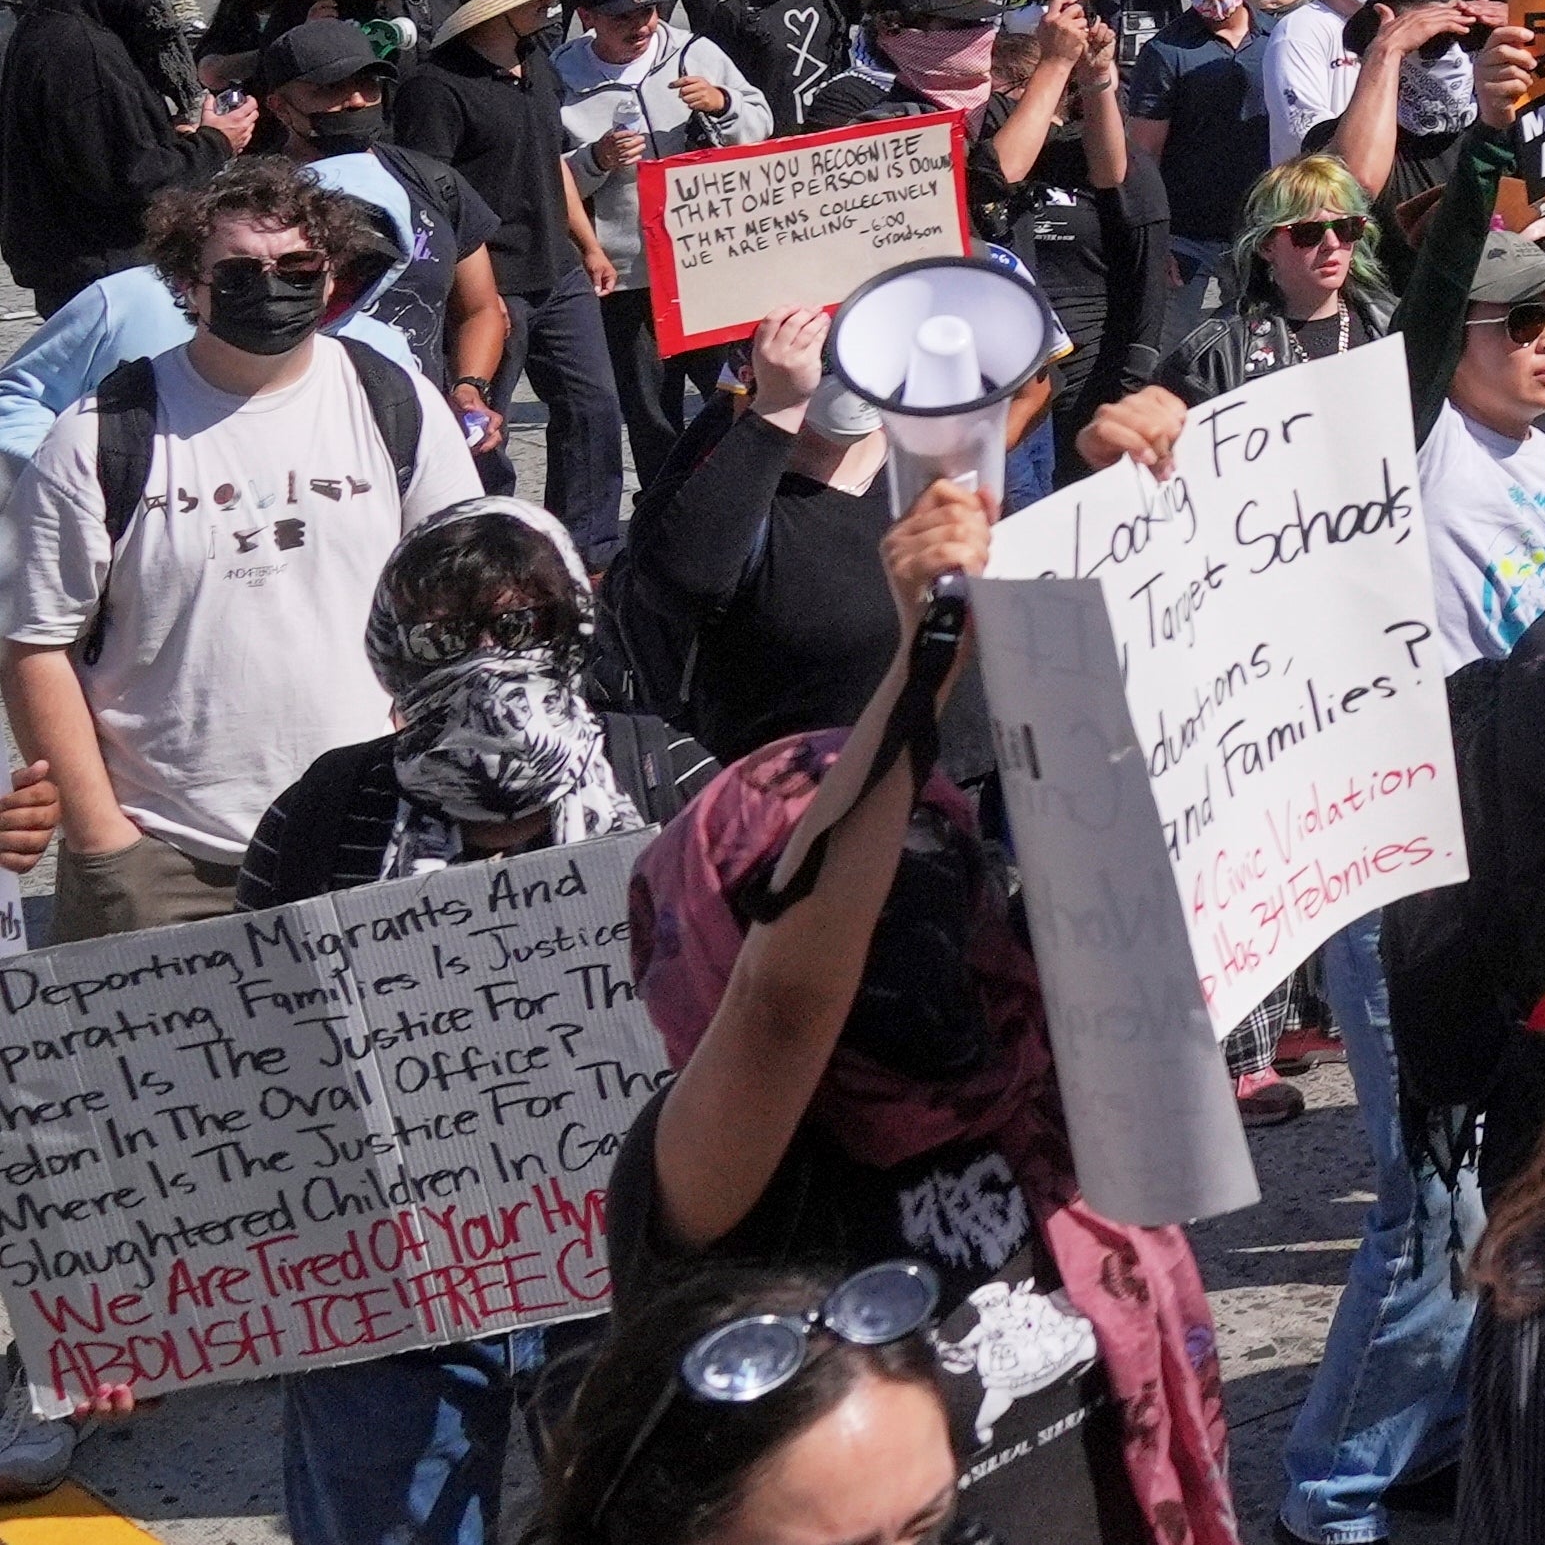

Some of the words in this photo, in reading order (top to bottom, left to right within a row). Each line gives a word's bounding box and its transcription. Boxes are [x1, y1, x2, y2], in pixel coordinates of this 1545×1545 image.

[671, 197, 733, 229] THAT
[741, 186, 786, 214] ONE
[792, 168, 879, 201] PERSON
[886, 161, 903, 179] IS
[674, 168, 752, 203] WHEN
[760, 157, 800, 188] YOU
[811, 133, 925, 178] RECOGNIZE
[677, 225, 736, 253] THAT
[745, 208, 810, 236] MEANS
[819, 180, 939, 218] COLLECTIVELY
[681, 252, 713, 270] WE
[728, 235, 770, 258] ARE
[777, 217, 859, 246] FAILING
[1198, 401, 1313, 478] For
[1130, 563, 1228, 652] Target
[1217, 620, 1434, 802] Families?
[1264, 762, 1438, 877] Violation
[1289, 837, 1455, 921] Felonies.
[2, 951, 244, 1015] Deporting
[245, 895, 473, 972] Migrants
[488, 860, 588, 914] And
[0, 999, 226, 1082] parating
[239, 971, 421, 1022] Families
[433, 944, 471, 977] Is
[468, 919, 633, 973] Justice
[119, 1053, 175, 1100] Is
[176, 1037, 289, 1083] The
[295, 1003, 474, 1068] Justice
[474, 979, 563, 1025] For
[565, 963, 638, 1011] Th
[0, 1180, 146, 1235] Where
[151, 1167, 198, 1199] Is
[190, 1140, 295, 1184] The
[296, 1110, 482, 1169] Justice
[480, 1079, 574, 1127] For
[2, 1143, 99, 1189] elon
[107, 1118, 151, 1160] In
[154, 1104, 253, 1150] The
[259, 1070, 374, 1121] Oval
[394, 1022, 585, 1096] Office?
[0, 1189, 297, 1290] Slaughtered
[303, 1165, 482, 1227] Children
[494, 1138, 548, 1183] In
[556, 1121, 634, 1173] Ga
[32, 1286, 154, 1335] We
[167, 1259, 258, 1315] Are
[247, 1228, 368, 1293] Tired
[368, 1207, 428, 1267] Of
[424, 1196, 534, 1266] Your
[406, 1250, 570, 1335] FREE
